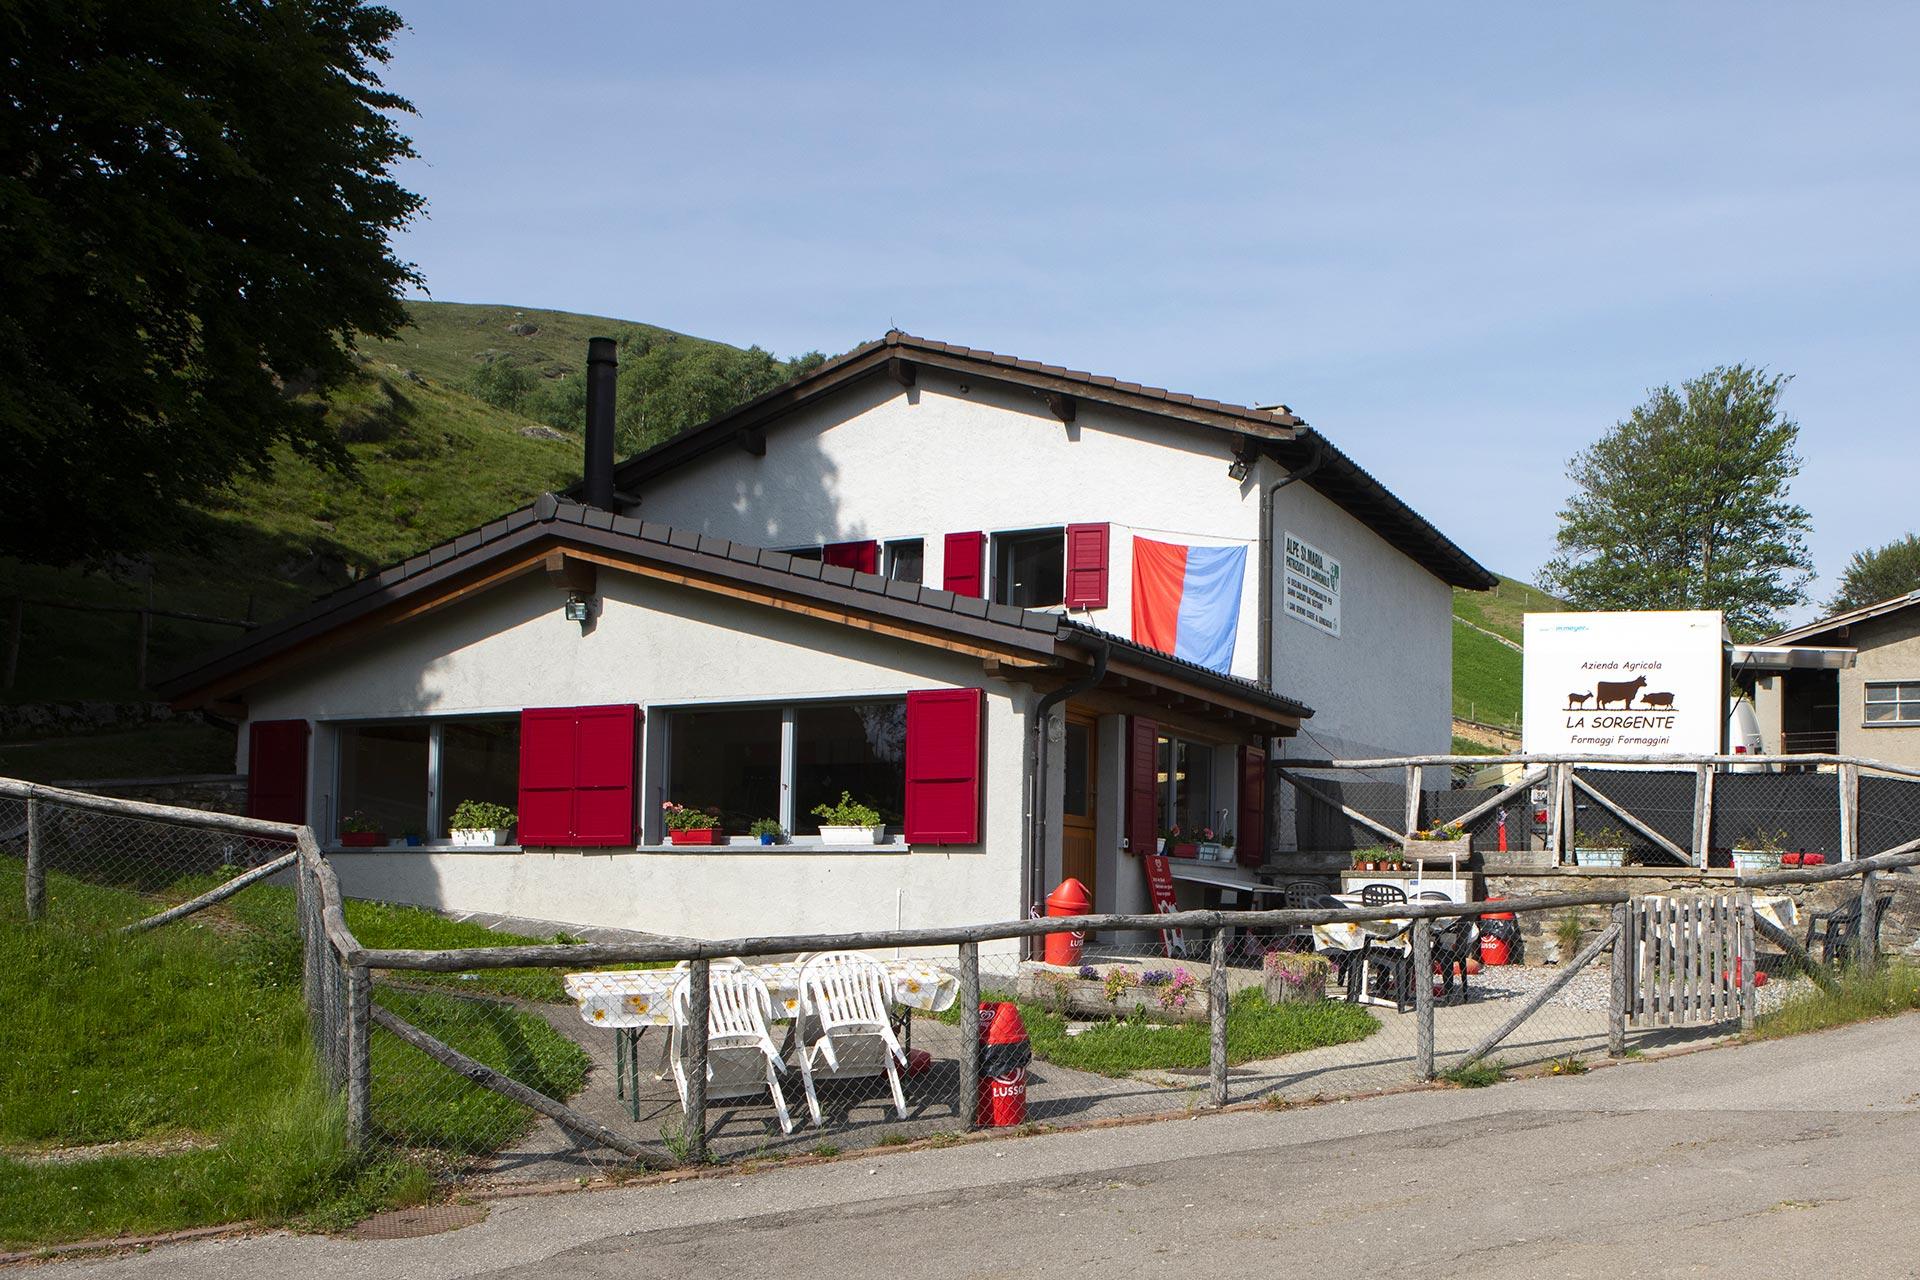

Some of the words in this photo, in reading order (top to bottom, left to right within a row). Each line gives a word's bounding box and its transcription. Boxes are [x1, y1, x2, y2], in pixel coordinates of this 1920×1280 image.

[1286, 538, 1300, 558] ALPE
[1581, 661, 1619, 670] Azienda
[1622, 661, 1663, 672] Agricola
[1566, 716, 1585, 729] LA
[1591, 716, 1676, 729] SORGENTE
[1570, 735, 1615, 746] Formaggi
[1617, 735, 1671, 746] Formaggini
[993, 1086, 1025, 1098] LUSSO
